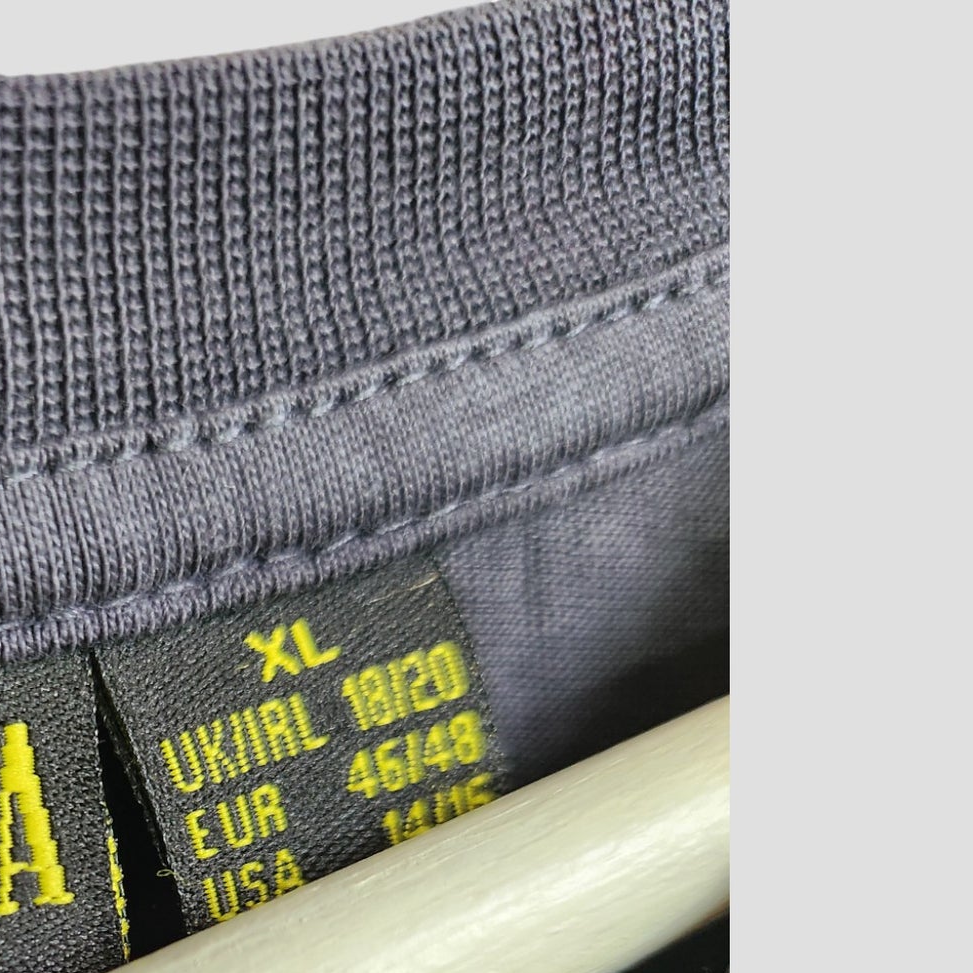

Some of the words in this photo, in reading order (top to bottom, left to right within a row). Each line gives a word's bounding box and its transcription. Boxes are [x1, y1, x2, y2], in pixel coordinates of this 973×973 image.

[244, 618, 342, 683] XL
[160, 693, 330, 793] UK/IRL
[341, 641, 469, 730] 18/20
[184, 783, 288, 860] EUR
[346, 711, 487, 799] 46/48
[202, 849, 306, 922] USA
